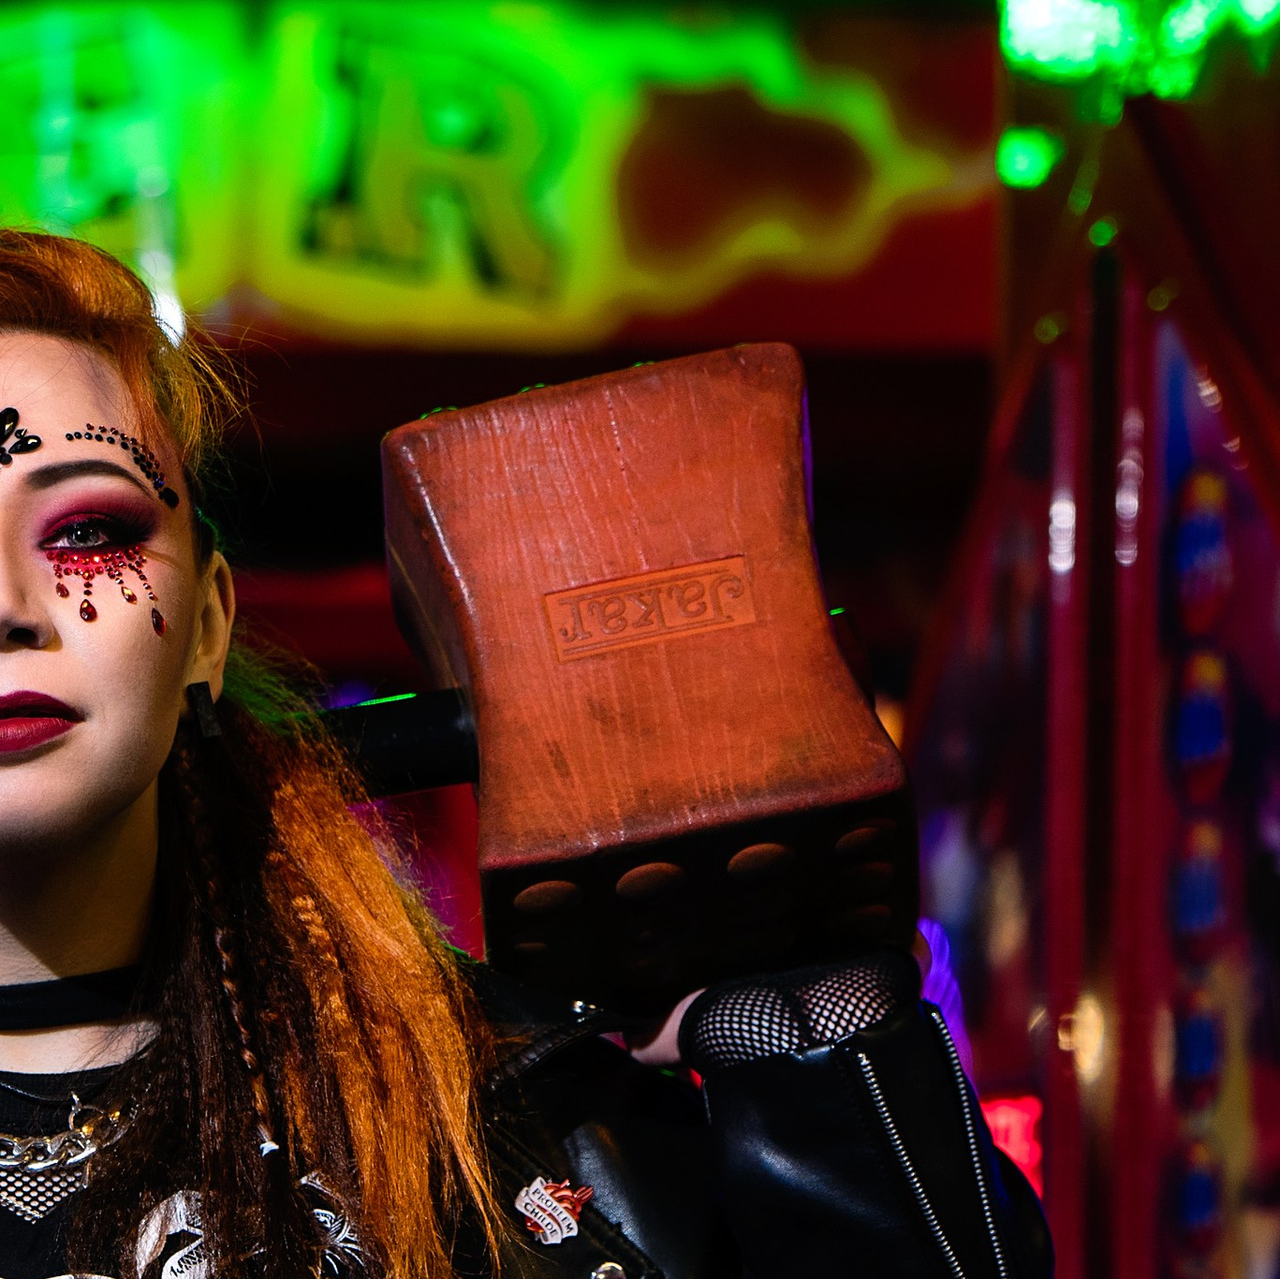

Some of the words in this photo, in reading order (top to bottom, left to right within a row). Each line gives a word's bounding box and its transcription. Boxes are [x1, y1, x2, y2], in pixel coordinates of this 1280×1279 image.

[558, 572, 745, 644] Jakar
[523, 1202, 559, 1238] CHILDE
[531, 1187, 574, 1234] PROBLEM
